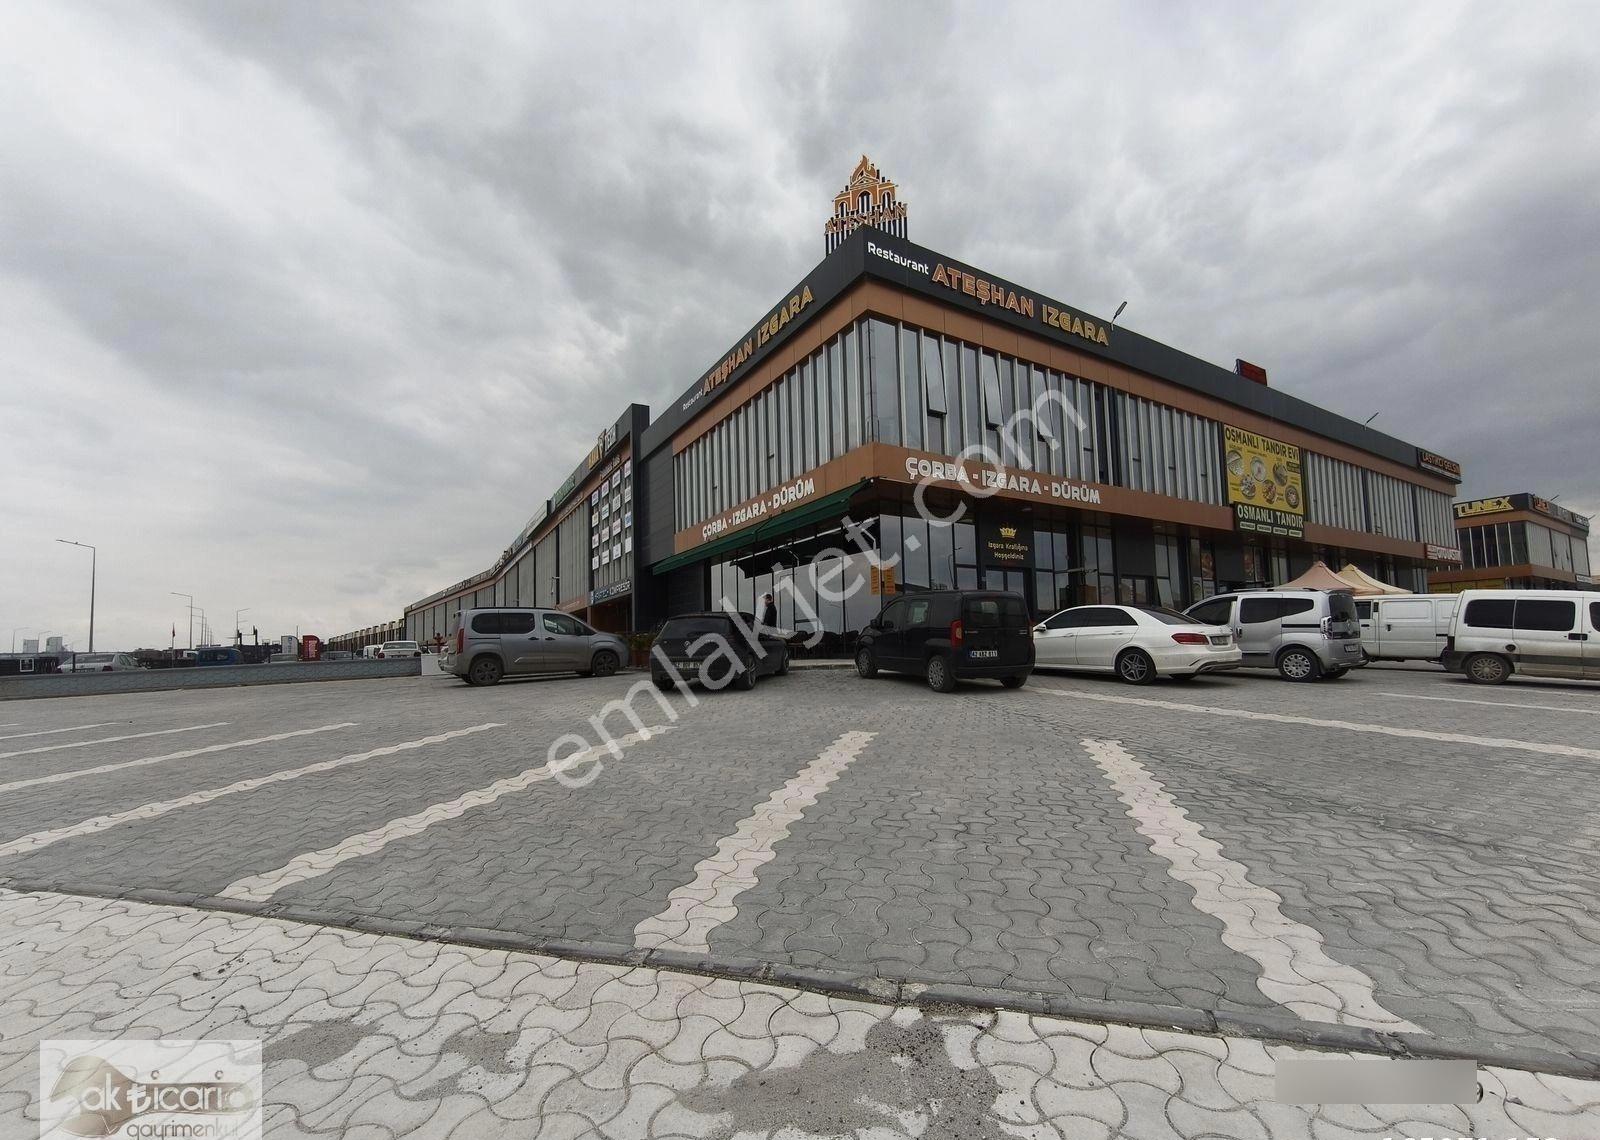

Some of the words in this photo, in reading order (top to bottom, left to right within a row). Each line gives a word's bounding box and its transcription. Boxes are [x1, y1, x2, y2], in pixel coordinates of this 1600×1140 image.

[867, 241, 929, 275] Restaurant
[932, 263, 1034, 319] ATEŞHAN
[1042, 304, 1109, 346] IZGARA
[703, 337, 753, 396] ATEŞHAN
[757, 285, 814, 347] IZGARA
[1225, 427, 1259, 449] OSMANLI
[905, 457, 969, 483] ÇORBA
[981, 469, 1041, 495] IZGARA
[1051, 481, 1100, 504] DÜRÜM
[702, 517, 728, 542] ÇORBA
[732, 500, 767, 526] IZGARA
[772, 477, 815, 509] DÜRÜM
[1237, 504, 1274, 524] OSMANLI
[1453, 496, 1514, 517] TUNEX
